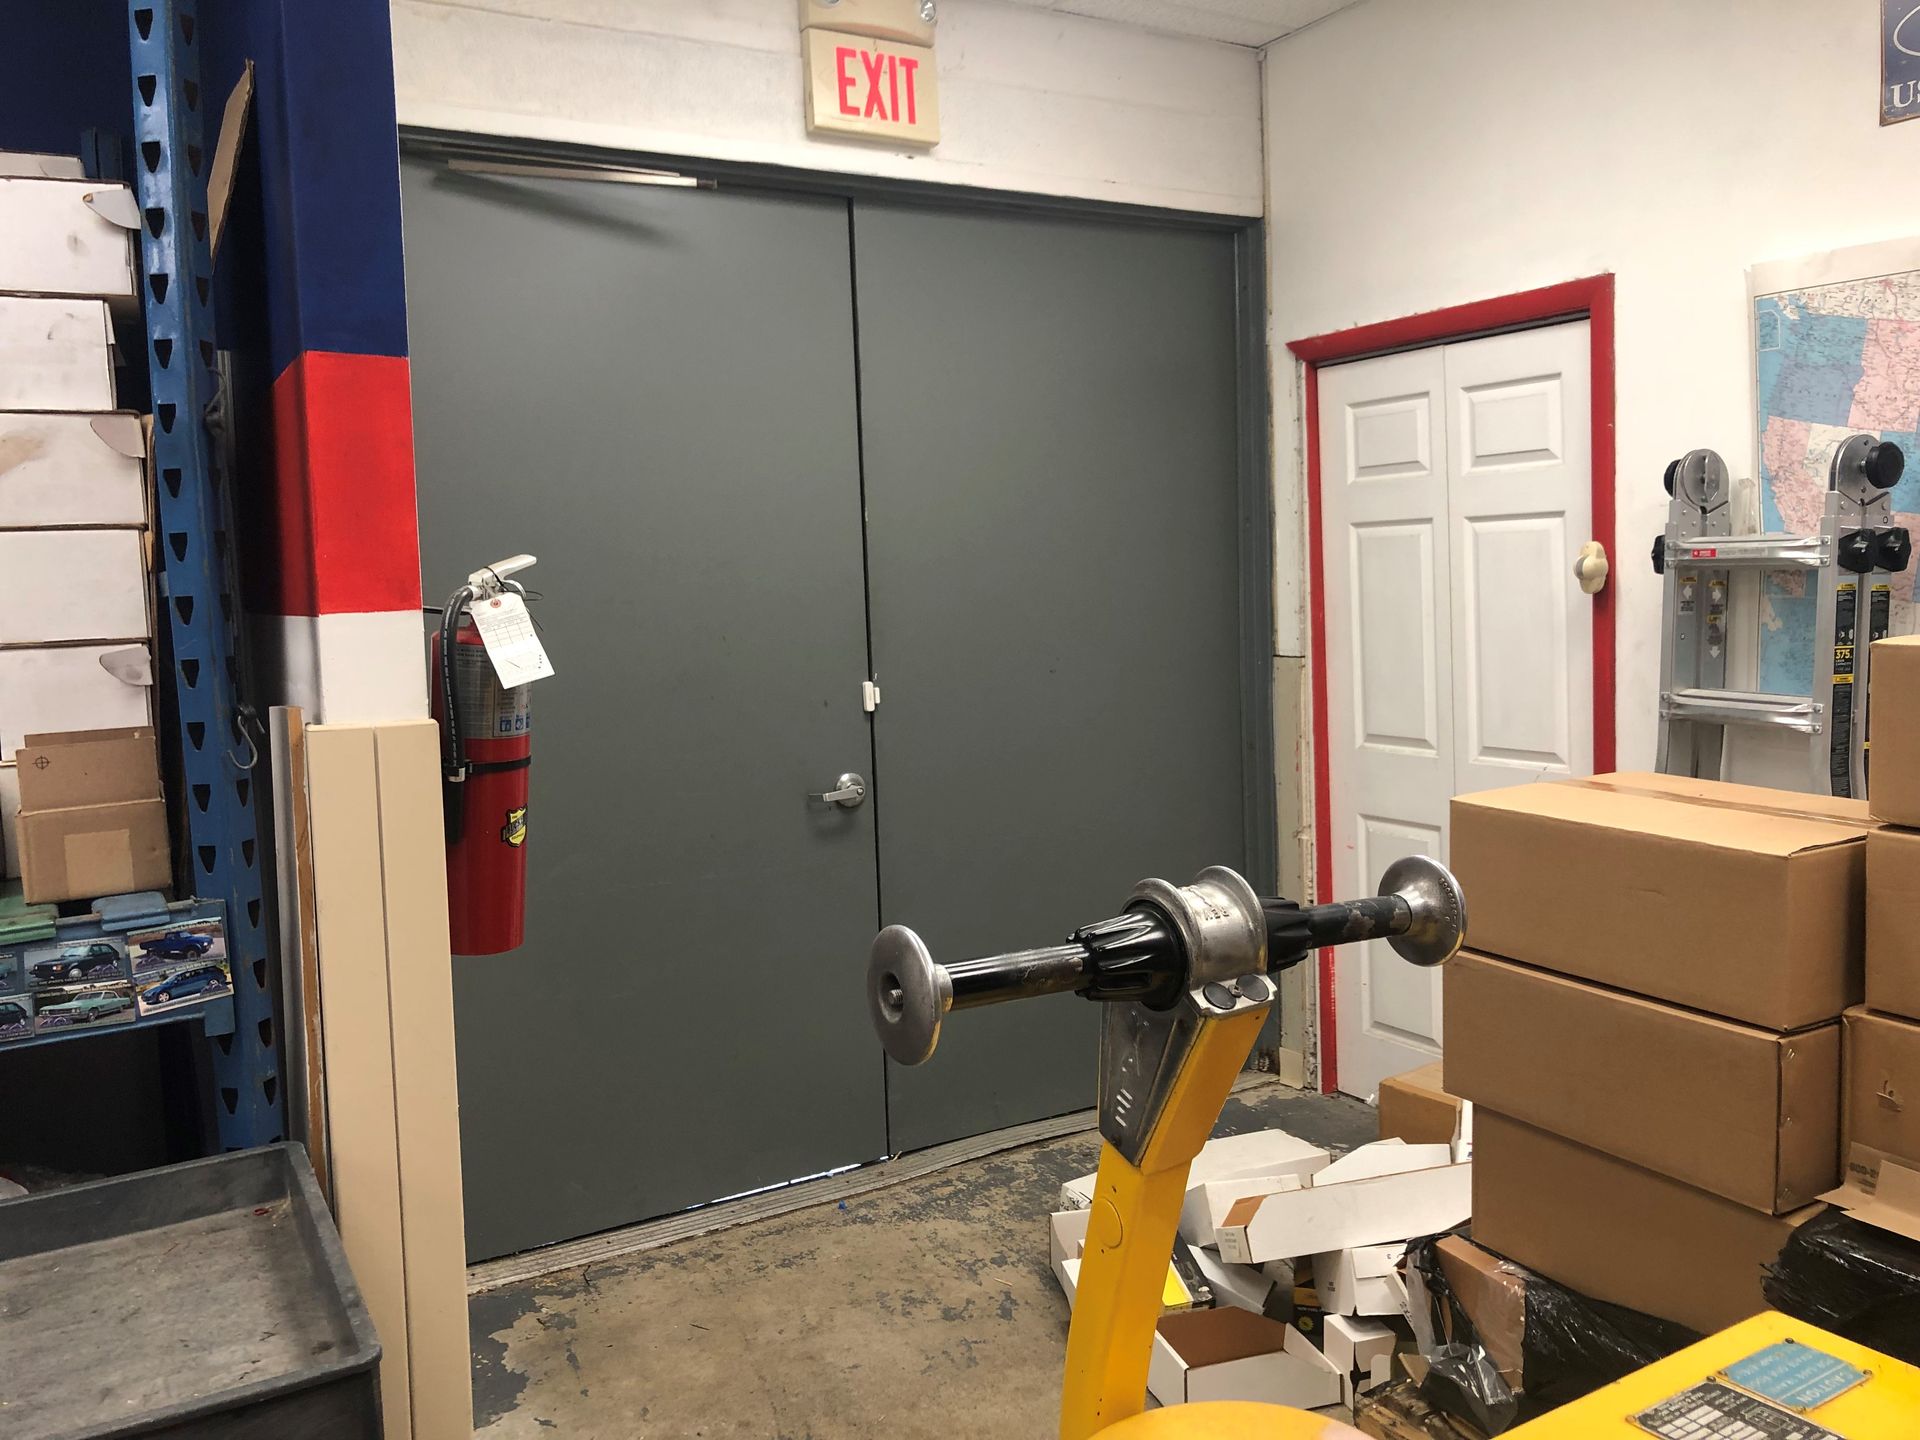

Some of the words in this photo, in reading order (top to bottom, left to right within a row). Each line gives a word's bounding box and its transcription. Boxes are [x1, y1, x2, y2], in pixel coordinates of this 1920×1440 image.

[835, 46, 919, 125] EXIT
[1890, 80, 1920, 108] U
[1835, 649, 1850, 659] 375
